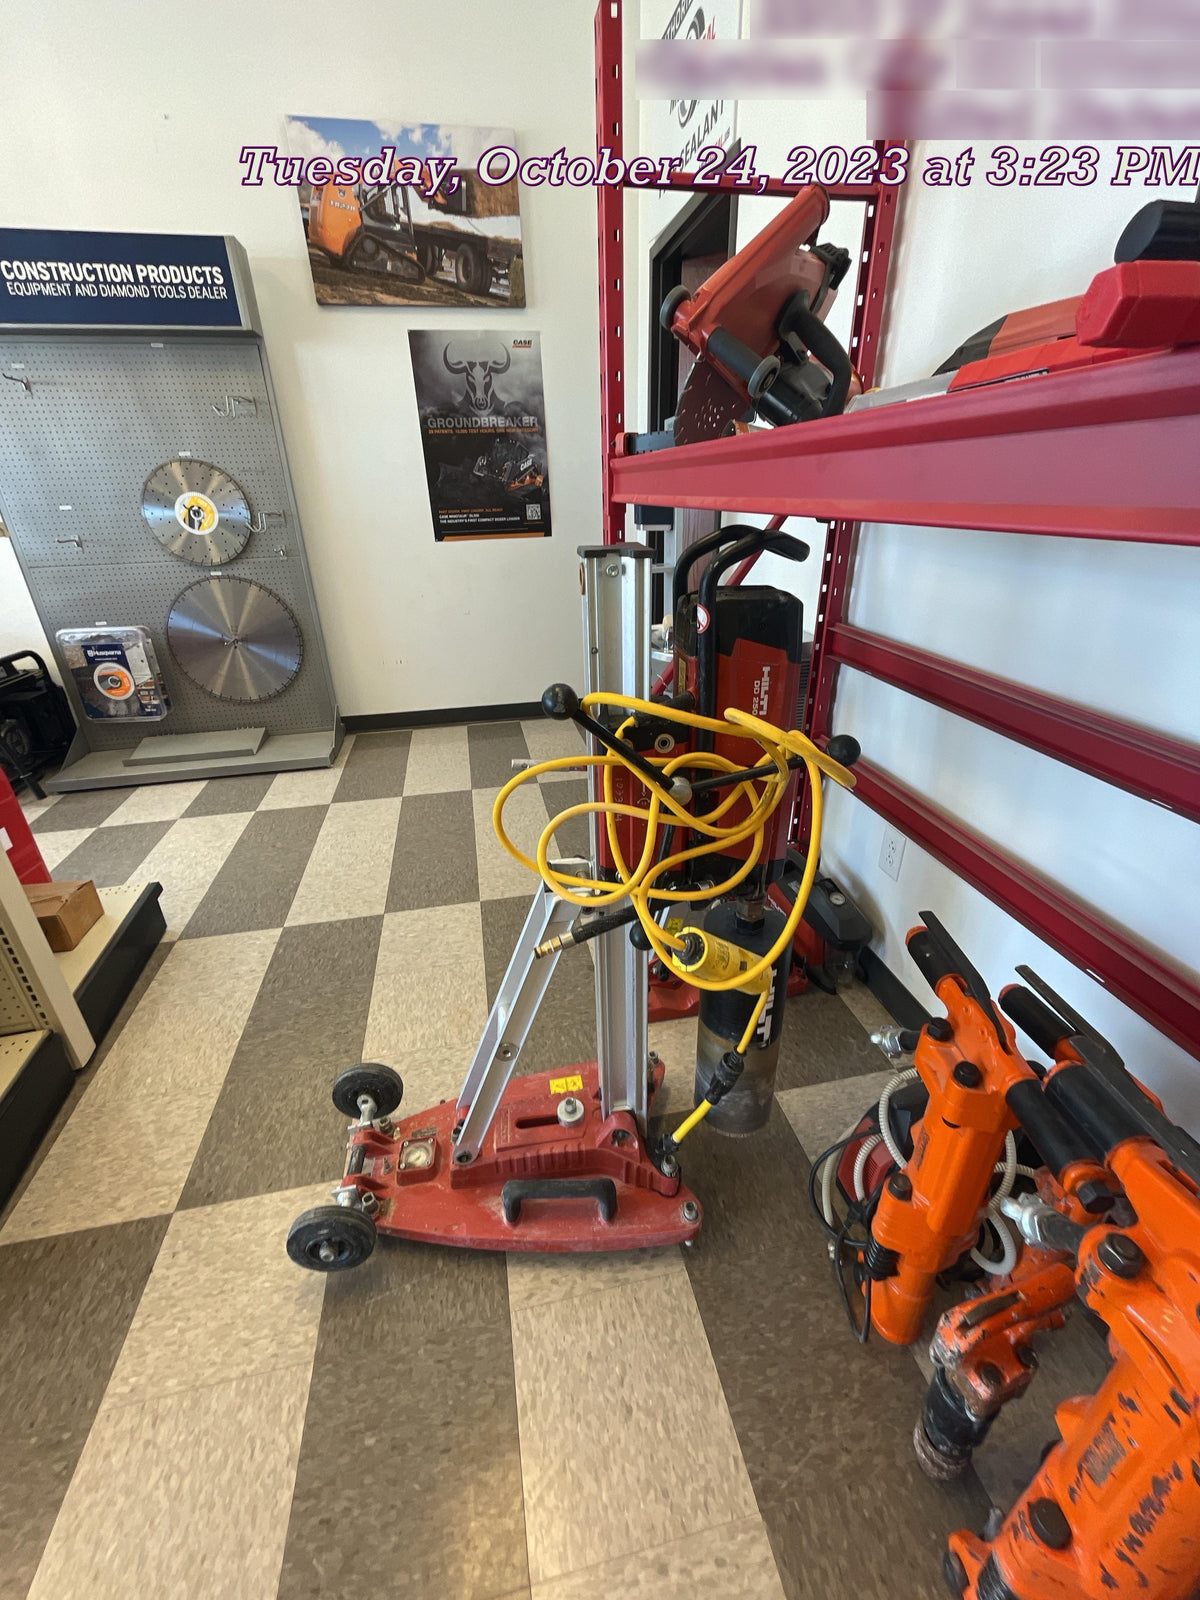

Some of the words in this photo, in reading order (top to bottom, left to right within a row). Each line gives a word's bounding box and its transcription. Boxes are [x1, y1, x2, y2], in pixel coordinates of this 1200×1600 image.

[0, 260, 135, 283] CONSTRUCTION
[136, 264, 224, 285] PRODUCTS
[6, 281, 73, 297] EQUIPMENT
[75, 283, 98, 297] AND
[100, 284, 150, 298] DIAMOND
[151, 285, 186, 299] TOOLS
[188, 285, 228, 300] DEALER
[427, 416, 538, 428] GROUNDBREAKER
[520, 458, 532, 471] CASE
[754, 680, 760, 694] DD
[759, 666, 771, 716] HILTI
